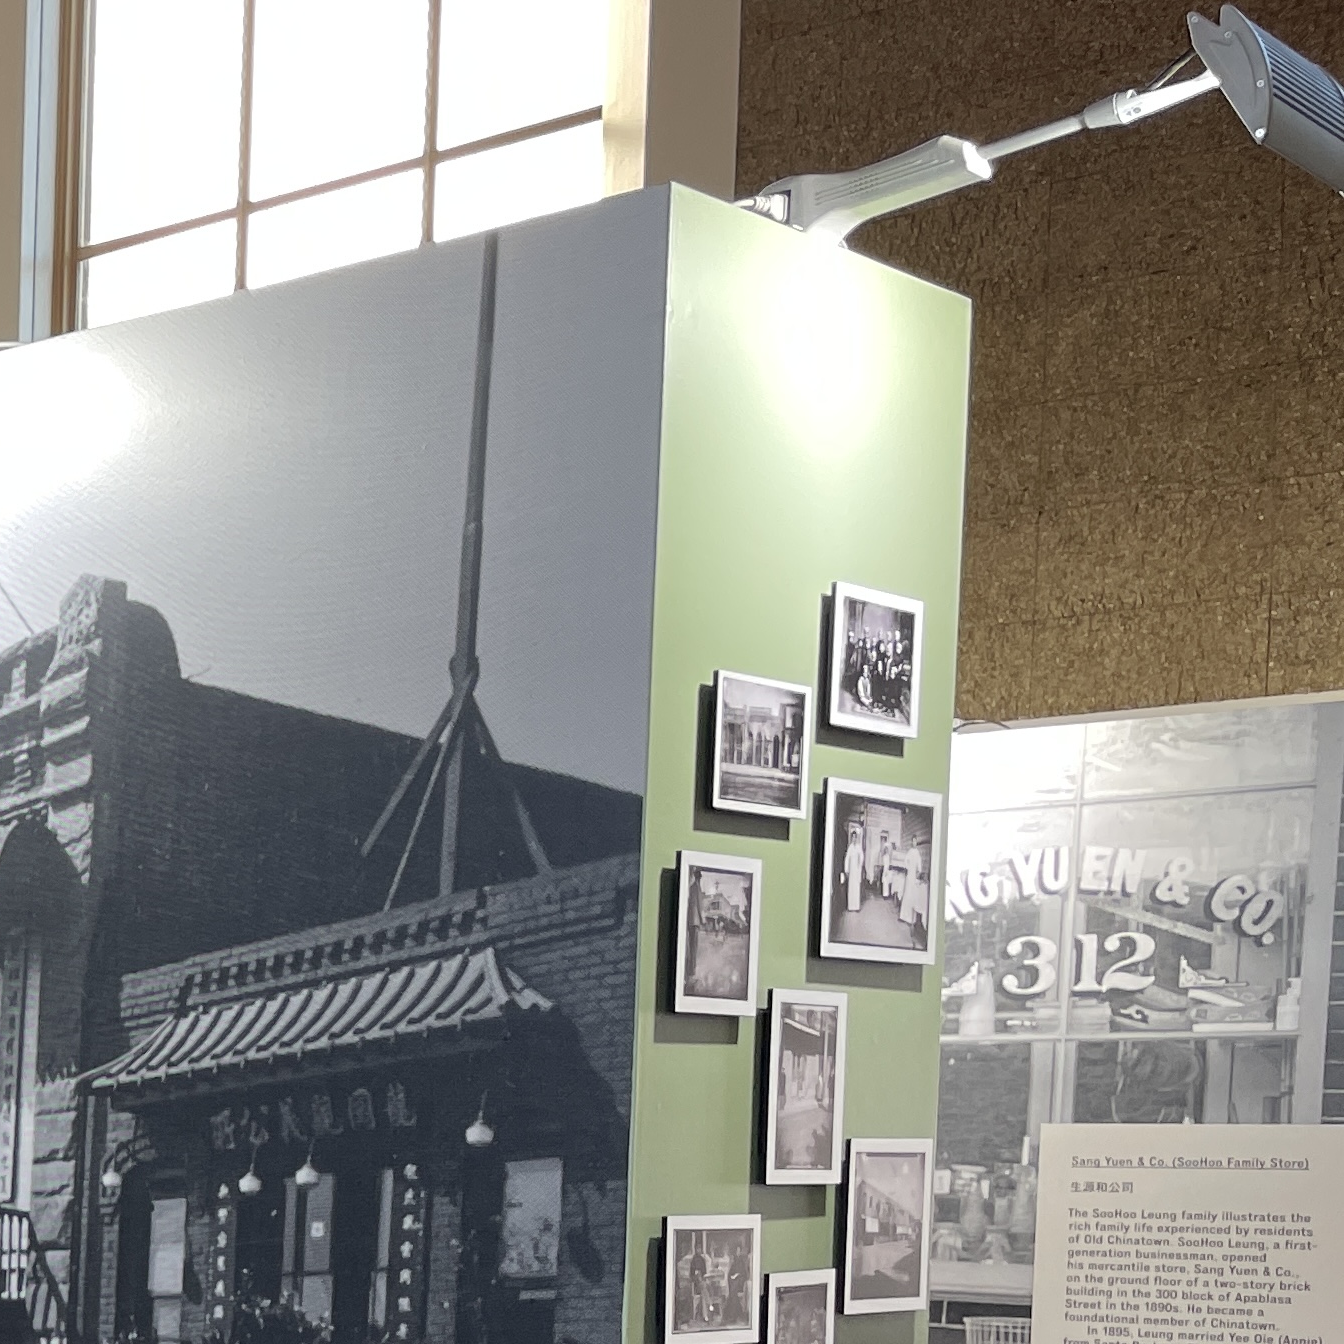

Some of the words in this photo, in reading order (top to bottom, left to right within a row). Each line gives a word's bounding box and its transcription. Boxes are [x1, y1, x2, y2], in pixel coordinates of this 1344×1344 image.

[1009, 845, 1147, 899] YUEN
[1155, 857, 1193, 905] &
[1002, 932, 1155, 995] 312
[1071, 1156, 1100, 1169] Sang
[1104, 1156, 1133, 1166] Yuen
[1137, 1156, 1145, 1166] &
[1149, 1156, 1167, 1166] Co.
[1171, 1156, 1223, 1170] (SooHoo
[1227, 1156, 1266, 1170] Family
[1269, 1157, 1309, 1170] Store)
[1068, 1207, 1088, 1218] The
[1092, 1208, 1137, 1219] SooHoo
[1140, 1209, 1177, 1222] Leung
[1181, 1210, 1218, 1223] family
[1221, 1211, 1287, 1223] illustrates
[1290, 1212, 1312, 1223] the
